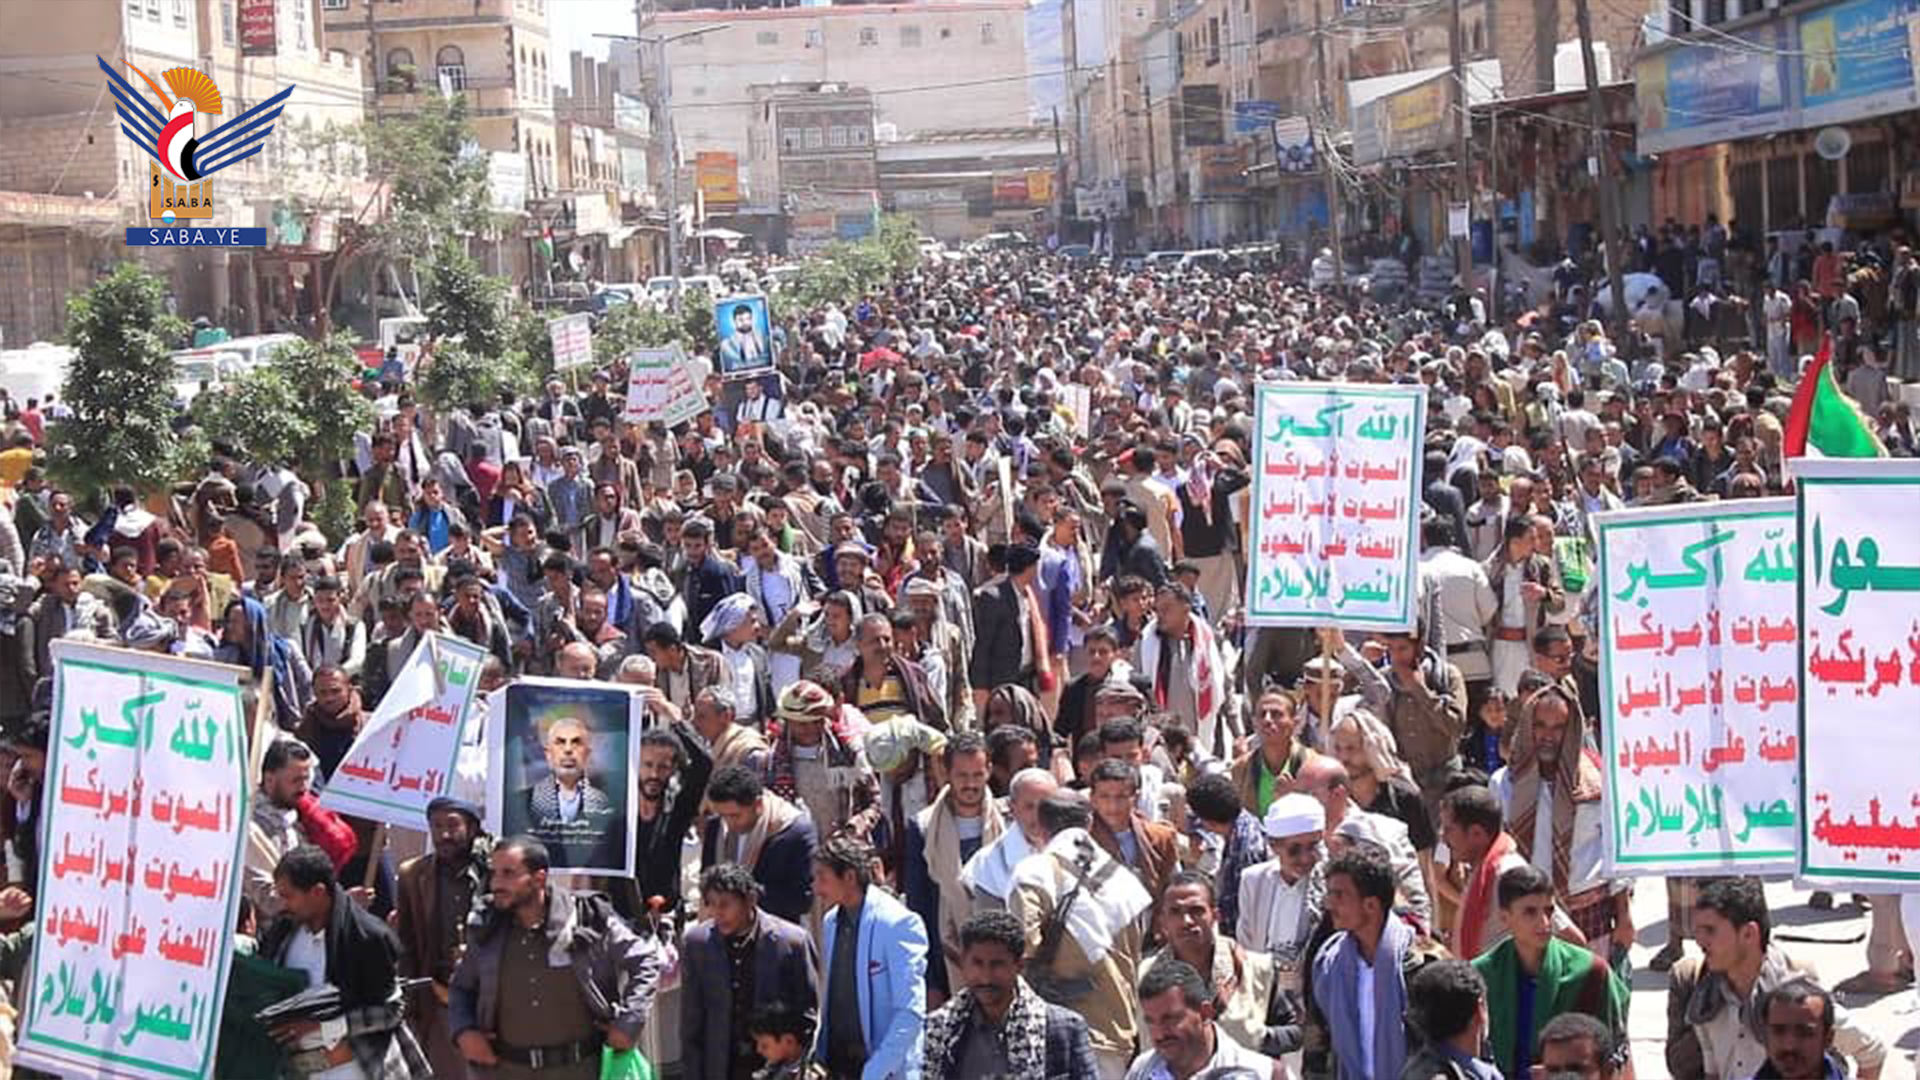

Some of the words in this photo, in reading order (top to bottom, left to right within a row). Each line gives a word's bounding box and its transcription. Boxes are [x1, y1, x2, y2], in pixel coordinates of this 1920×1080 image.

[1345, 457, 1407, 485] الموت
[1343, 496, 1405, 523] الموت
[1261, 532, 1312, 558] اليهود
[1320, 534, 1346, 559] على
[1356, 532, 1401, 559] اللعنة
[1335, 568, 1400, 608] النصر
[1731, 615, 1796, 652] موت
[1734, 675, 1796, 711] موت
[1619, 730, 1690, 775] اليهود
[1702, 730, 1745, 773] على
[150, 791, 232, 835] الموت
[144, 855, 229, 902] الموت
[46, 902, 109, 951] اليهود
[111, 915, 147, 961] على
[158, 916, 216, 969] اللعنة
[119, 979, 207, 1045] النصر
